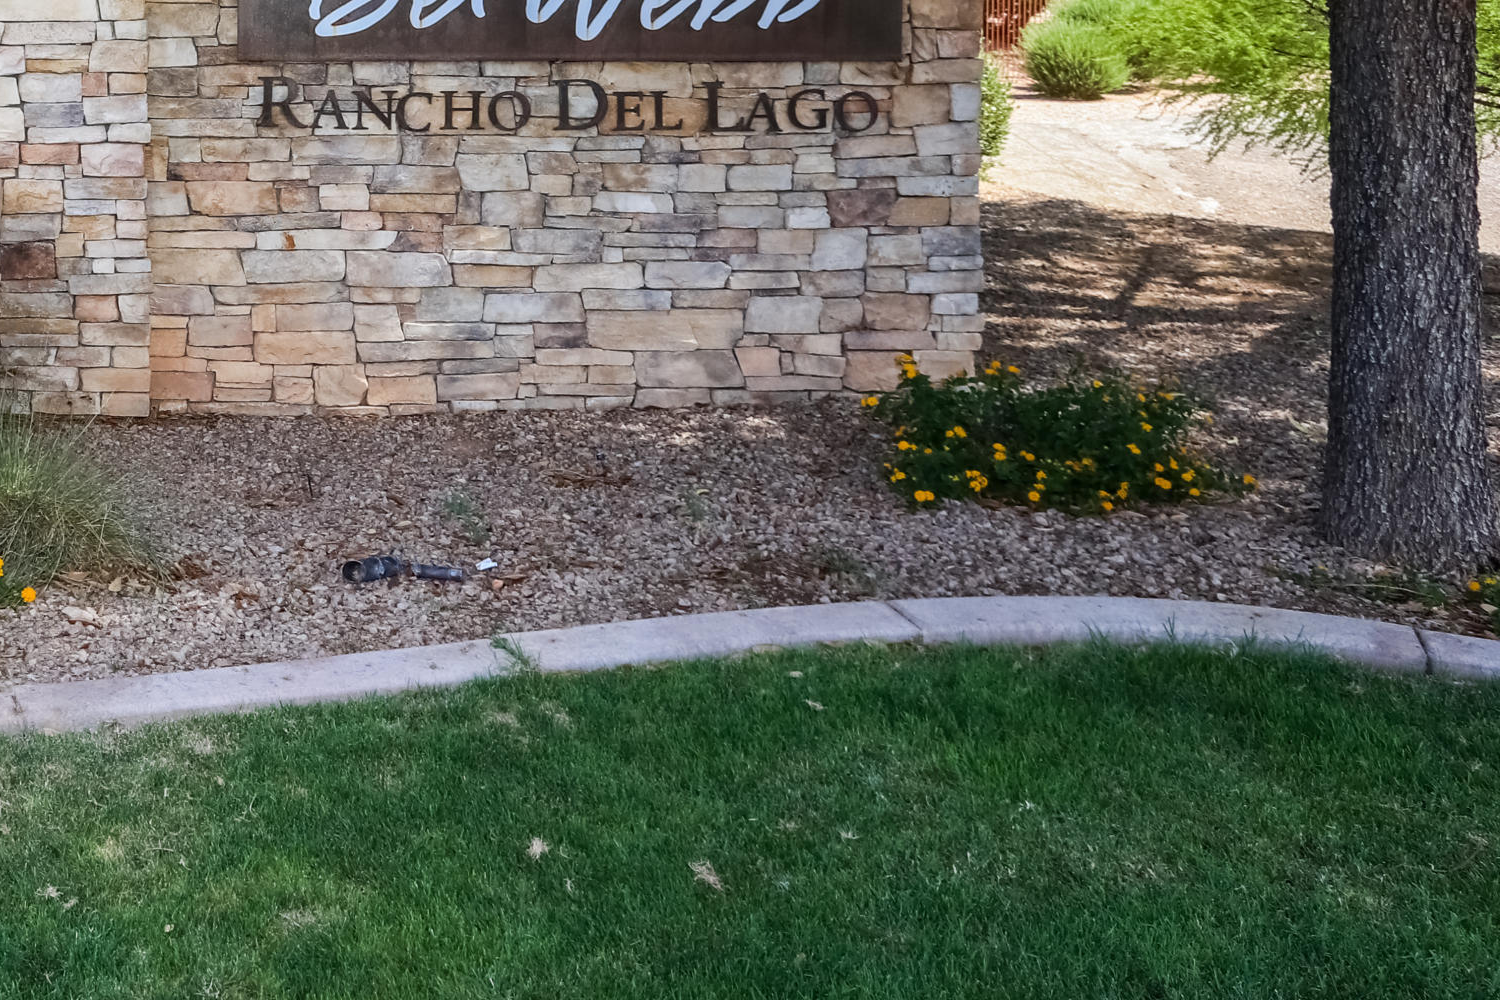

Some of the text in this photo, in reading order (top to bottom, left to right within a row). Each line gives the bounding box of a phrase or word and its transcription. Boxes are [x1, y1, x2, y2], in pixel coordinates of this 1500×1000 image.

[256, 74, 879, 133] RANCHO DEL LAGO
